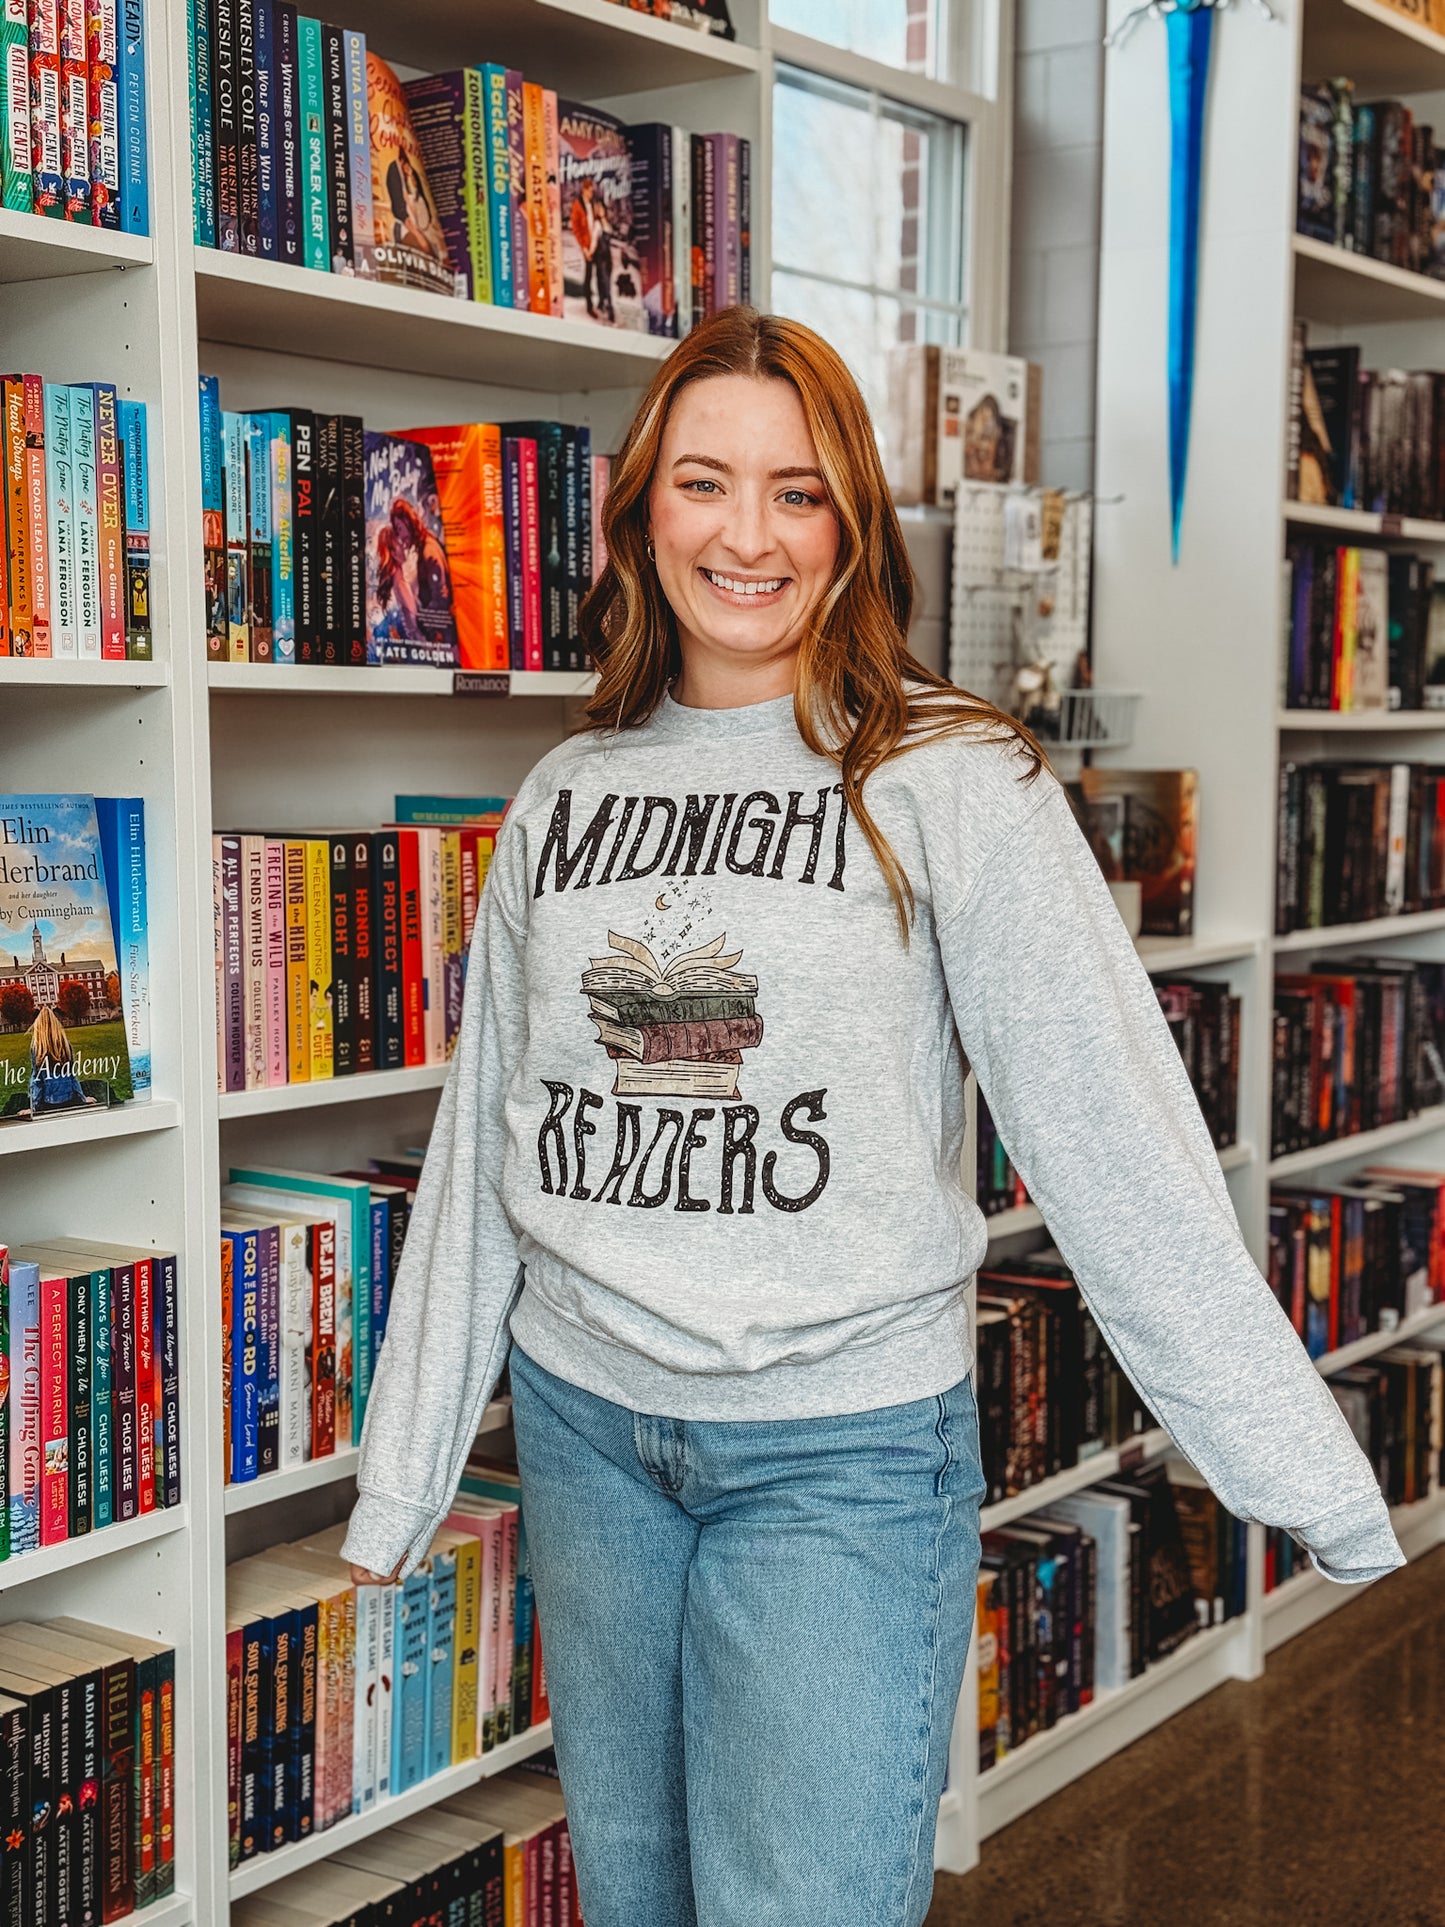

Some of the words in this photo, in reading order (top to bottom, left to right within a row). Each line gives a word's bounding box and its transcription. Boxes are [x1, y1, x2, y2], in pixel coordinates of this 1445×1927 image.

[103, 5, 114, 62] STRANGER
[218, 0, 231, 75] KRESLEY
[240, 0, 253, 81] KRESLEY
[306, 26, 316, 69] OLIVIA
[198, 36, 208, 95] COUSENS
[330, 37, 340, 79] OLIVIA
[350, 37, 362, 94] OLIVIA
[12, 47, 27, 116] KATHERINE
[129, 72, 139, 122] PEYTON
[257, 70, 268, 108] WOLF
[281, 63, 292, 117] WITCHES
[307, 74, 317, 107] DADE
[331, 85, 341, 117] DADE
[220, 79, 233, 129] COLE
[242, 85, 254, 135] COLE
[353, 99, 364, 145] DADE
[14, 121, 29, 170] CENTER
[259, 113, 270, 149] GONE
[333, 124, 343, 149] ALL
[491, 73, 508, 195] Backslide
[131, 127, 141, 184] CORINNE
[259, 155, 271, 191] WILD
[284, 140, 294, 198] STITCHES
[309, 138, 322, 192] SPOILER
[335, 152, 345, 178] THE
[337, 183, 347, 223] FEELS
[531, 165, 543, 205] LAST
[311, 196, 323, 241] ALERT
[499, 205, 508, 236] Nora
[500, 241, 510, 281] Dahlia
[536, 240, 546, 274] LIST
[9, 393, 23, 432] Heart
[55, 392, 69, 412] The
[77, 396, 92, 416] The
[53, 415, 69, 457] Mating
[75, 418, 92, 458] Mating
[99, 390, 117, 464] NEVER
[10, 436, 27, 481] Strings
[32, 454, 40, 475] ALL
[297, 424, 311, 471] PEN
[566, 442, 575, 468] THE
[56, 460, 71, 493] Game
[78, 463, 94, 495] Game
[526, 461, 534, 483] BIG
[33, 479, 42, 519] ROADS
[102, 473, 119, 528] OVER
[297, 479, 311, 517] PAL
[527, 487, 535, 525] WITCH
[567, 472, 576, 528] WRONG
[58, 519, 66, 554] LANA
[80, 521, 89, 555] LANA
[528, 527, 537, 573] ENERGY
[567, 531, 577, 578] HEART
[17, 529, 26, 600] FAIRBANKS
[36, 556, 44, 572] TO
[37, 575, 45, 609] ROME
[59, 559, 68, 627] FERGUSON
[81, 560, 91, 627] FERGUSON
[455, 674, 510, 692] Romance
[20, 802, 64, 810] BESTSELLING
[2, 816, 50, 845] Elin
[129, 813, 140, 841] Elin
[533, 782, 858, 900] MIDNIGHT
[227, 858, 237, 878] ALL
[251, 852, 261, 864] IT
[268, 847, 282, 909] FREEING
[288, 848, 304, 905] RIDING
[8, 892, 20, 900] and
[22, 891, 31, 899] her
[32, 890, 58, 900] daughter
[130, 846, 143, 933] Hilderbrand
[228, 881, 238, 911] YOUR
[251, 869, 262, 905] ENDS
[313, 866, 321, 917] HELENA
[17, 904, 94, 920] Cunningham
[251, 909, 262, 944] WITH
[335, 893, 348, 955] FIGHT
[356, 889, 369, 958] HONOR
[383, 881, 398, 972] PROTECT
[228, 916, 239, 974] PERFECTS
[252, 950, 263, 967] US
[269, 930, 283, 968] WILD
[289, 926, 305, 963] HIGH
[313, 920, 323, 975] HUNTING
[128, 943, 140, 994] Five-Star
[130, 996, 141, 1046] Weekend
[231, 982, 239, 1023] COLLEEN
[231, 1026, 240, 1063] HOOVER
[36, 1054, 121, 1081] Academy
[537, 1078, 831, 1215] READERS
[319, 1230, 333, 1280] DEJA
[52, 1289, 61, 1300] A
[98, 1275, 107, 1322] ALWAYS
[122, 1274, 130, 1301] WITH
[165, 1266, 173, 1293] EVER
[122, 1305, 130, 1329] YOU
[165, 1295, 174, 1328] AFTER
[319, 1283, 334, 1335] BREW
[24, 1323, 40, 1361] The
[52, 1304, 61, 1370] PERFECT
[97, 1327, 109, 1352] Only
[122, 1332, 132, 1373] Forever
[164, 1330, 175, 1370] Always
[97, 1358, 109, 1381] You
[290, 1348, 298, 1392] MARNI
[19, 1366, 40, 1442] Cuffing
[52, 1375, 62, 1436] PAIRING
[140, 1403, 150, 1444] CHLOE
[168, 1402, 177, 1442] CHLOE
[290, 1401, 298, 1440] MANN
[77, 1427, 87, 1469] CHLOE
[99, 1413, 108, 1456] CHLOE
[122, 1412, 132, 1454] CHLOE
[24, 1446, 40, 1508] Game
[99, 1459, 108, 1492] LIESE
[122, 1457, 132, 1492] LIESE
[141, 1447, 151, 1480] LIESE
[168, 1445, 177, 1479] LIESE
[77, 1473, 87, 1508] LIESE
[245, 1641, 258, 1669] SOUL
[61, 1689, 69, 1720] DARK
[84, 1683, 94, 1748] RADIANT
[108, 1672, 128, 1749] REEL
[245, 1670, 258, 1743] SEARCHING
[34, 1734, 42, 1766] RUIN
[43, 1712, 51, 1779] MIDNIGHT
[61, 1723, 69, 1784] RESTRAINT
[85, 1753, 94, 1778] SIN
[82, 1813, 90, 1853] KATEE
[109, 1783, 121, 1851] KENNEDY
[59, 1869, 67, 1919] ROBERT
[82, 1858, 90, 1908] ROBERT
[109, 1856, 121, 1893] RYAN
